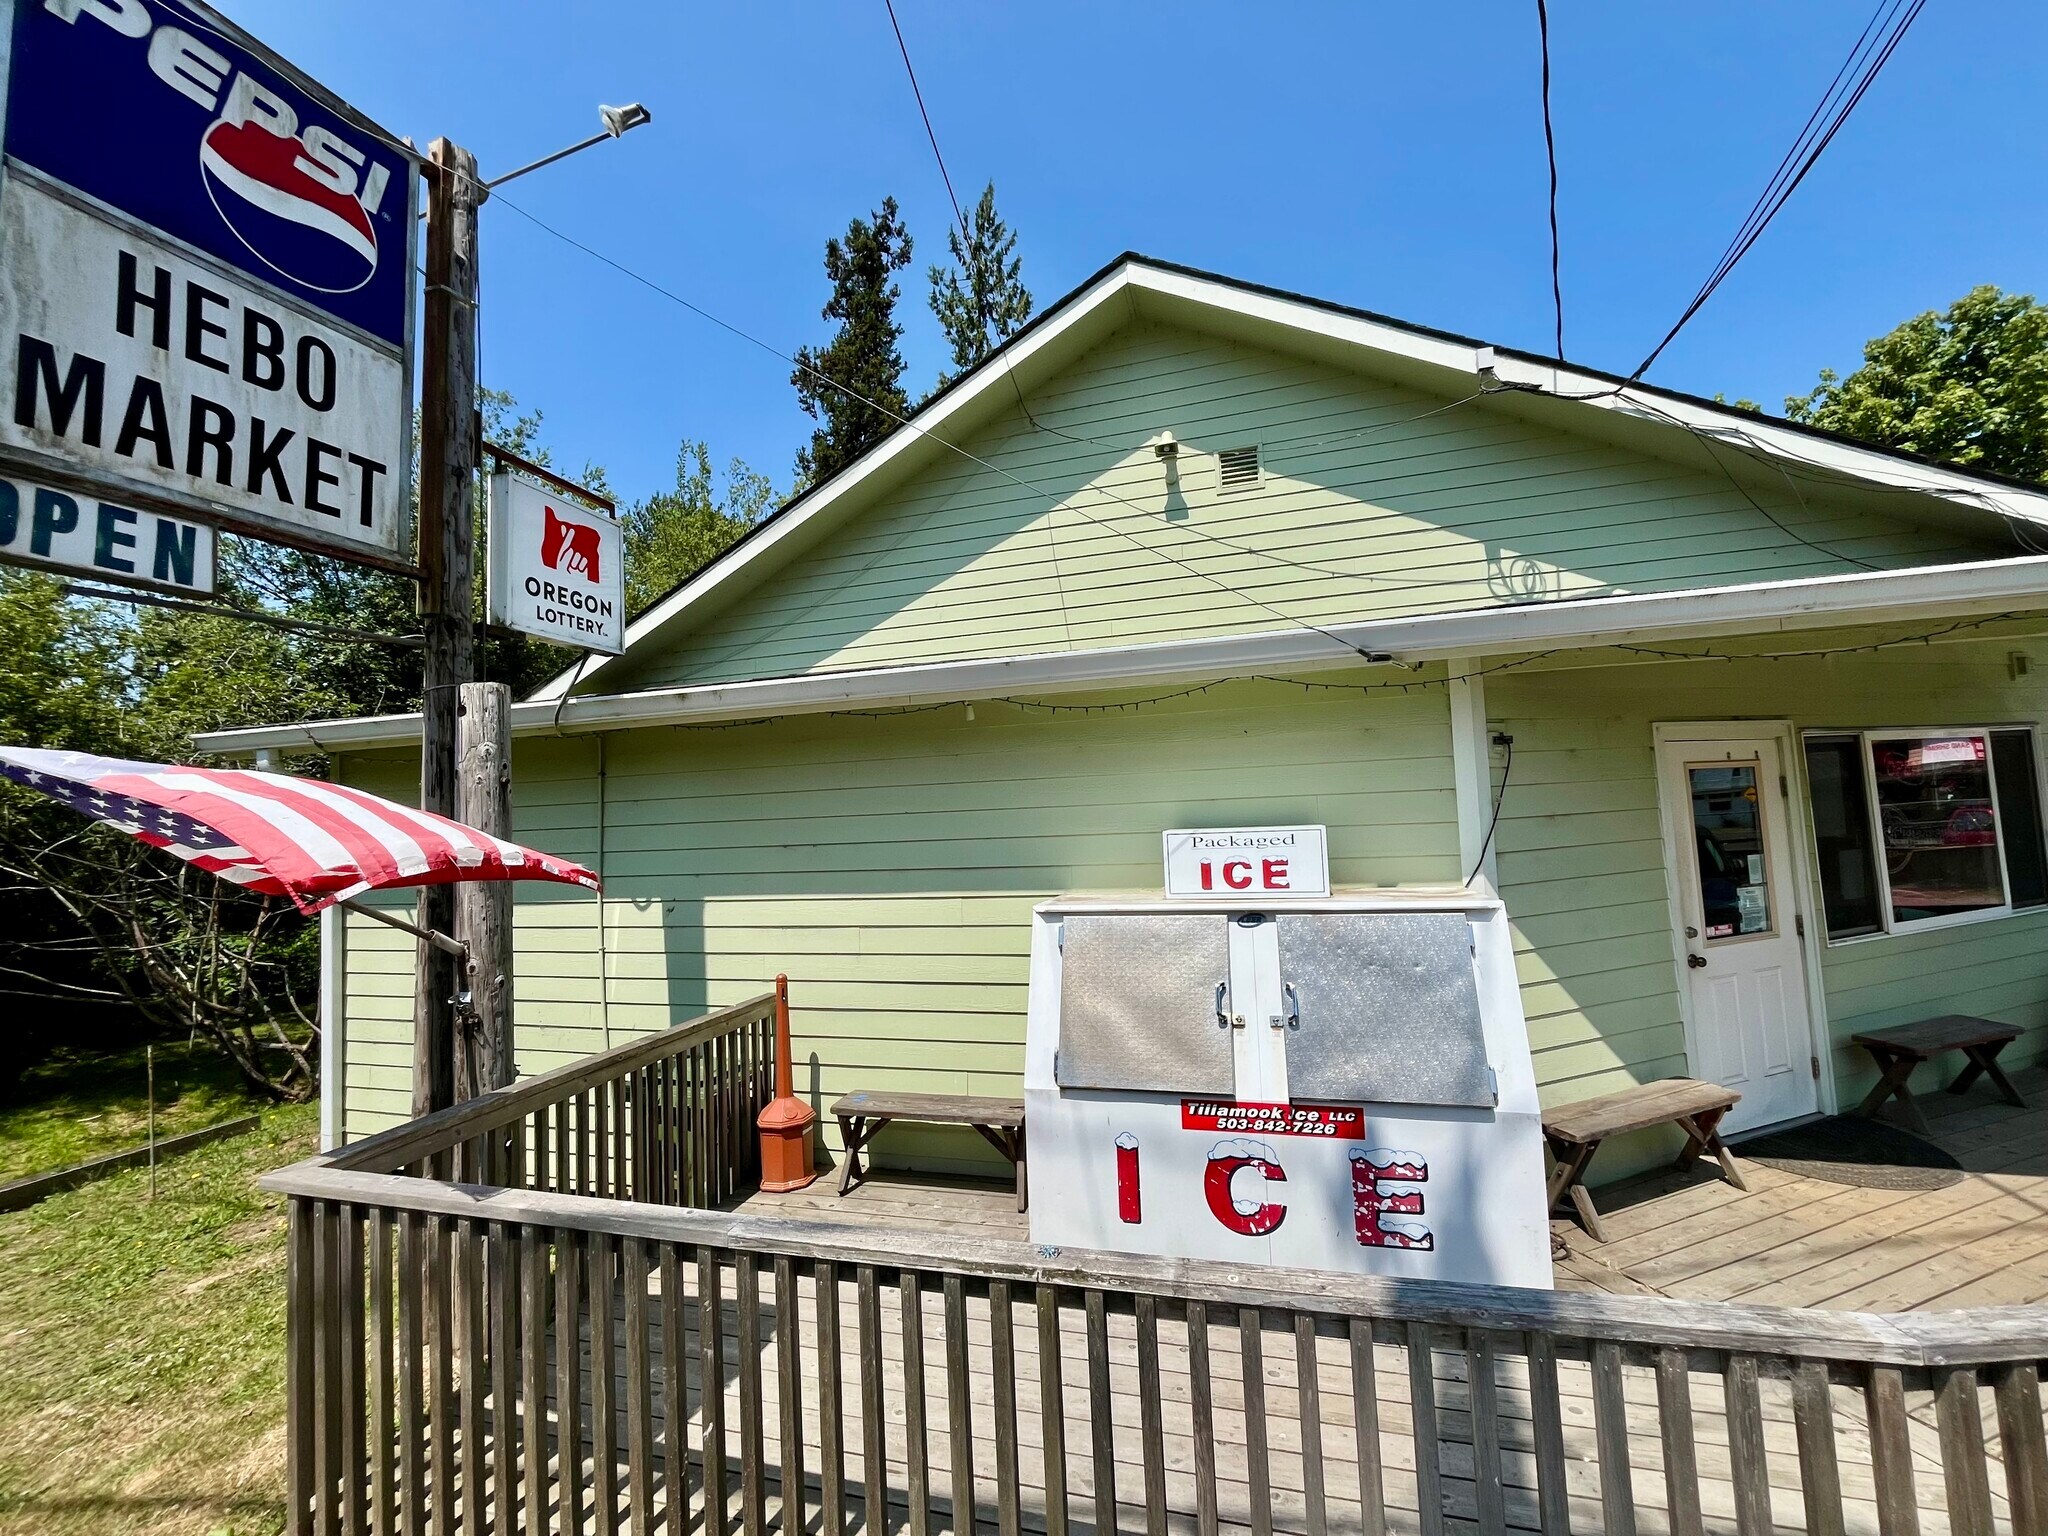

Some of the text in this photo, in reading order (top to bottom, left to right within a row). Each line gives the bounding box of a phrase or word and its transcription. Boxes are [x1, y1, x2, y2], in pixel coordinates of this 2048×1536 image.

[116, 250, 336, 412] HEBO
[14, 334, 387, 528] MARKET
[525, 576, 612, 618] OREGON
[536, 605, 604, 636] LOTTERY
[1192, 834, 1297, 849] Packaged
[1200, 855, 1290, 890] ICE
[1187, 1102, 1284, 1120] Tillamook
[1328, 1112, 1356, 1122] LLC
[1216, 1117, 1336, 1135] 503-842-7226
[1115, 1131, 1434, 1251] ICE
